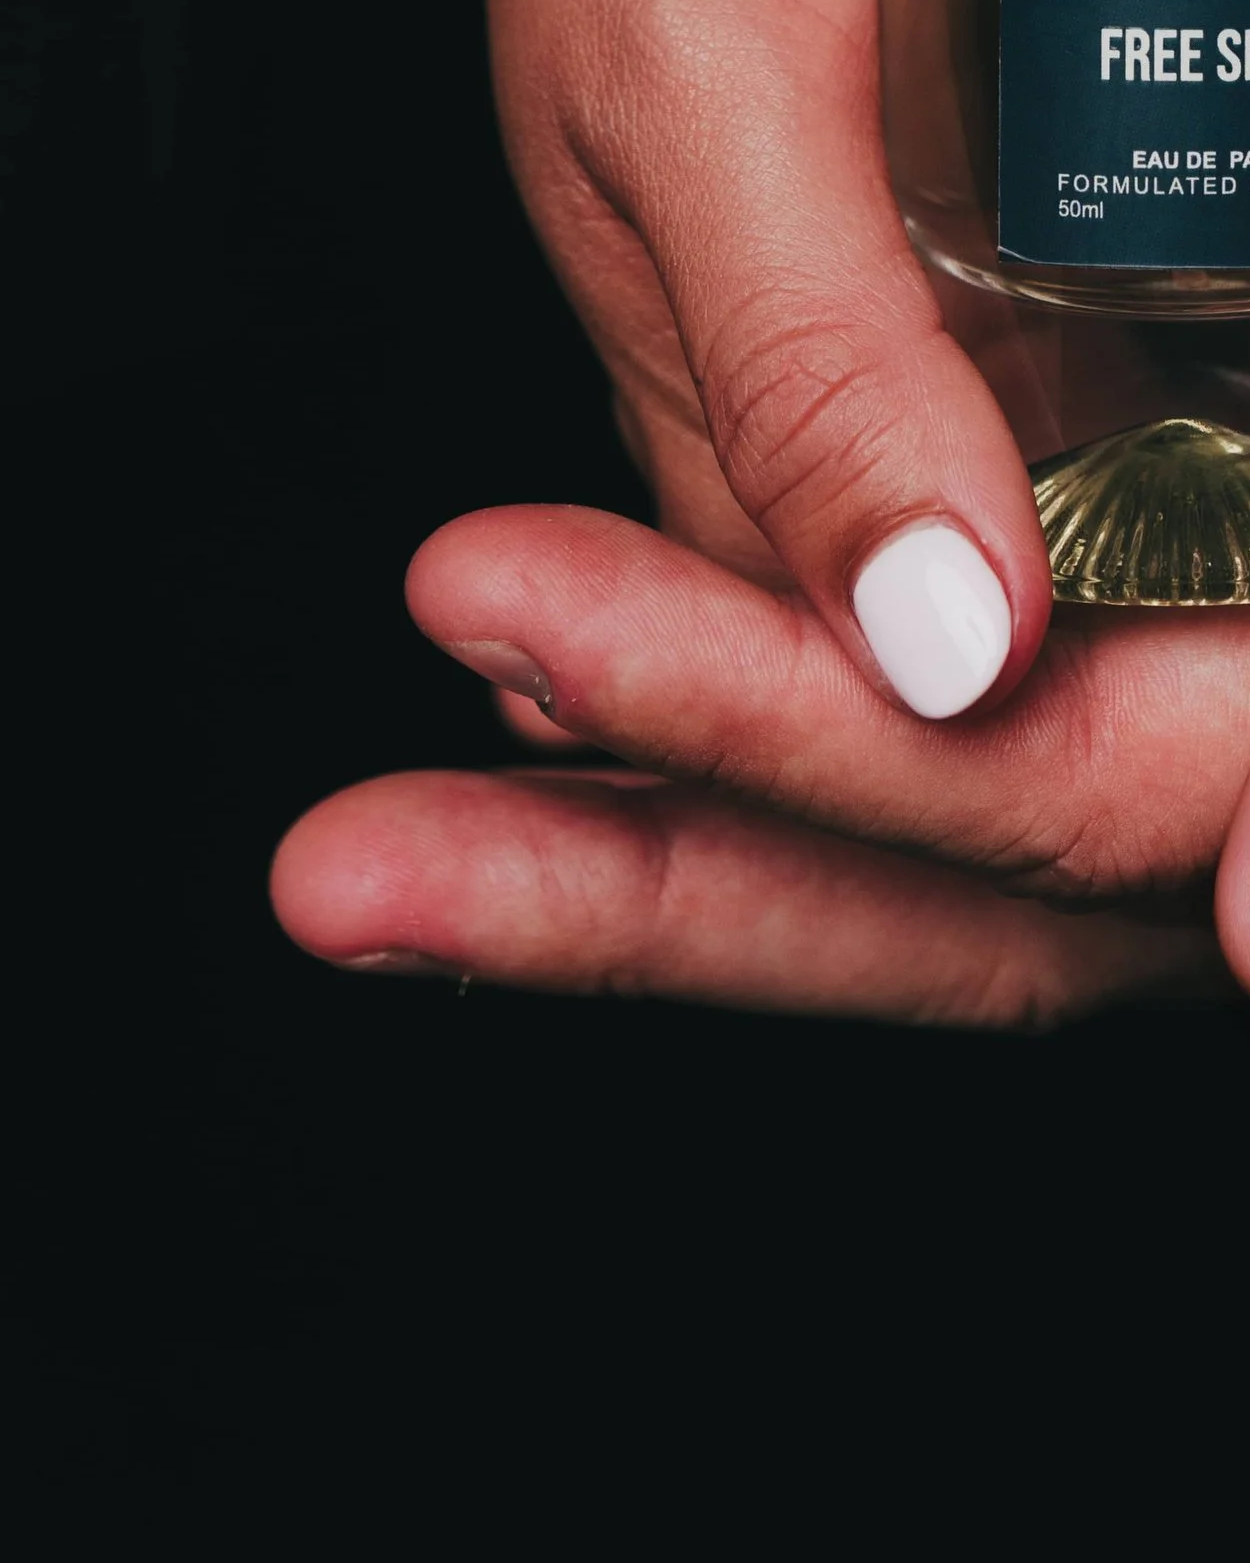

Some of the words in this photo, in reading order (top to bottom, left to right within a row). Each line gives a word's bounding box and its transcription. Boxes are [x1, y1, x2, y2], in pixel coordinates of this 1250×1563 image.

[1100, 26, 1204, 82] FREE
[1132, 150, 1179, 170] EAU
[1186, 150, 1217, 170] DE
[1058, 173, 1237, 195] FORMULATED
[1058, 199, 1104, 219] 50ml
